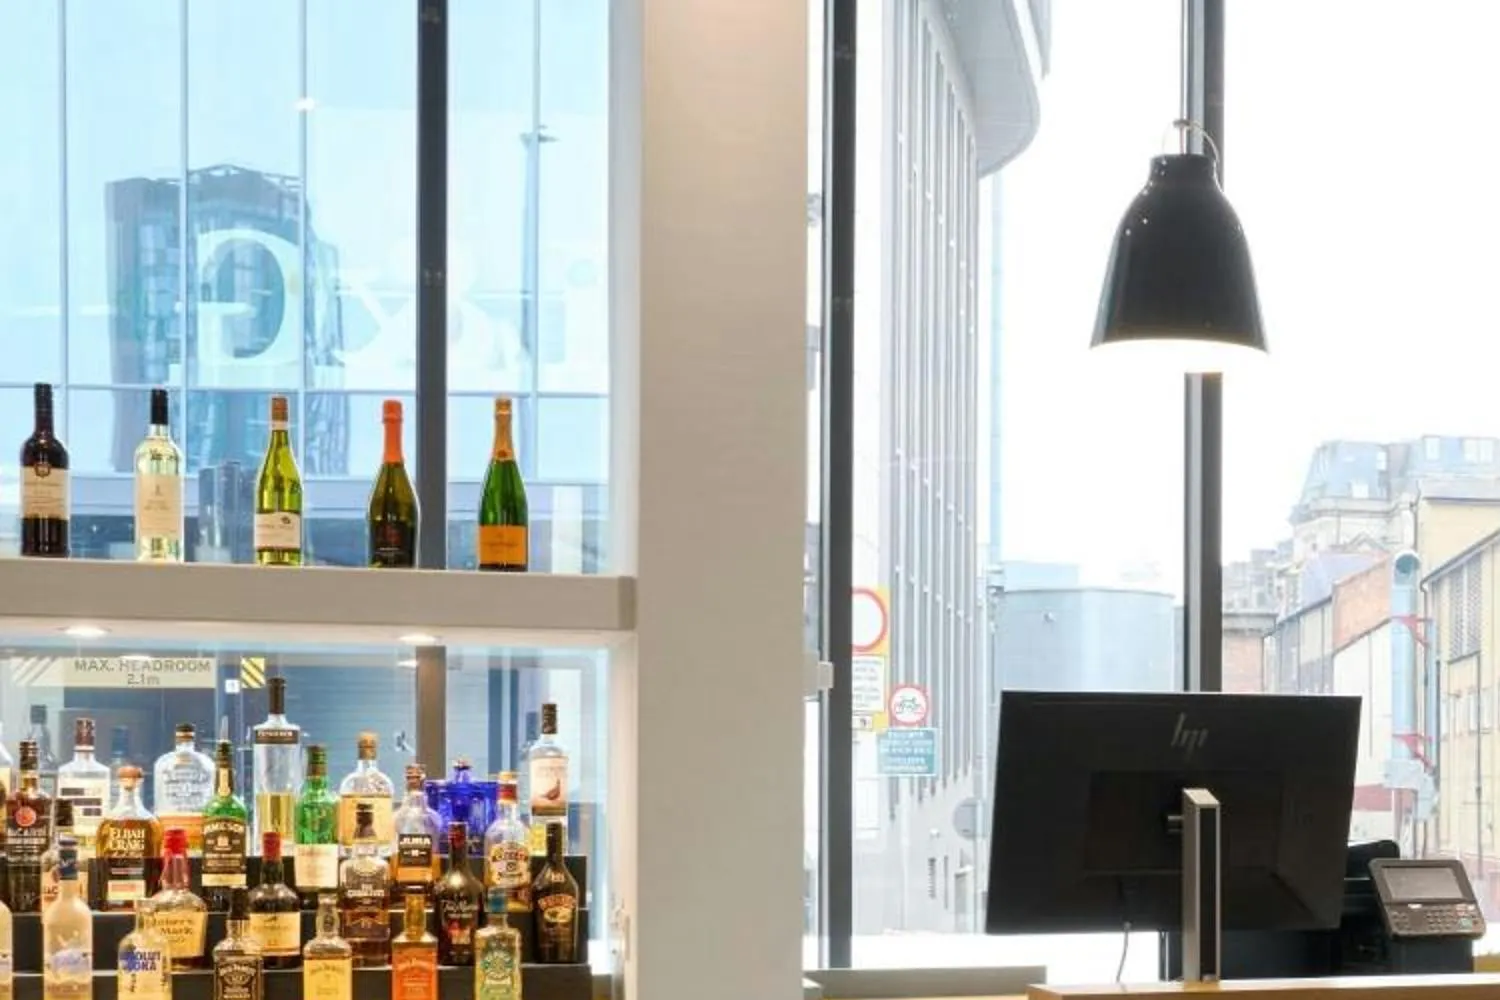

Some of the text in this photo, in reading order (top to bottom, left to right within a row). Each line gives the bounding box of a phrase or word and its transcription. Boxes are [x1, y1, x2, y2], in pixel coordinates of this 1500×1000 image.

[74, 658, 211, 673] MAX. HEADROOM
[127, 673, 160, 686] 2.1m
